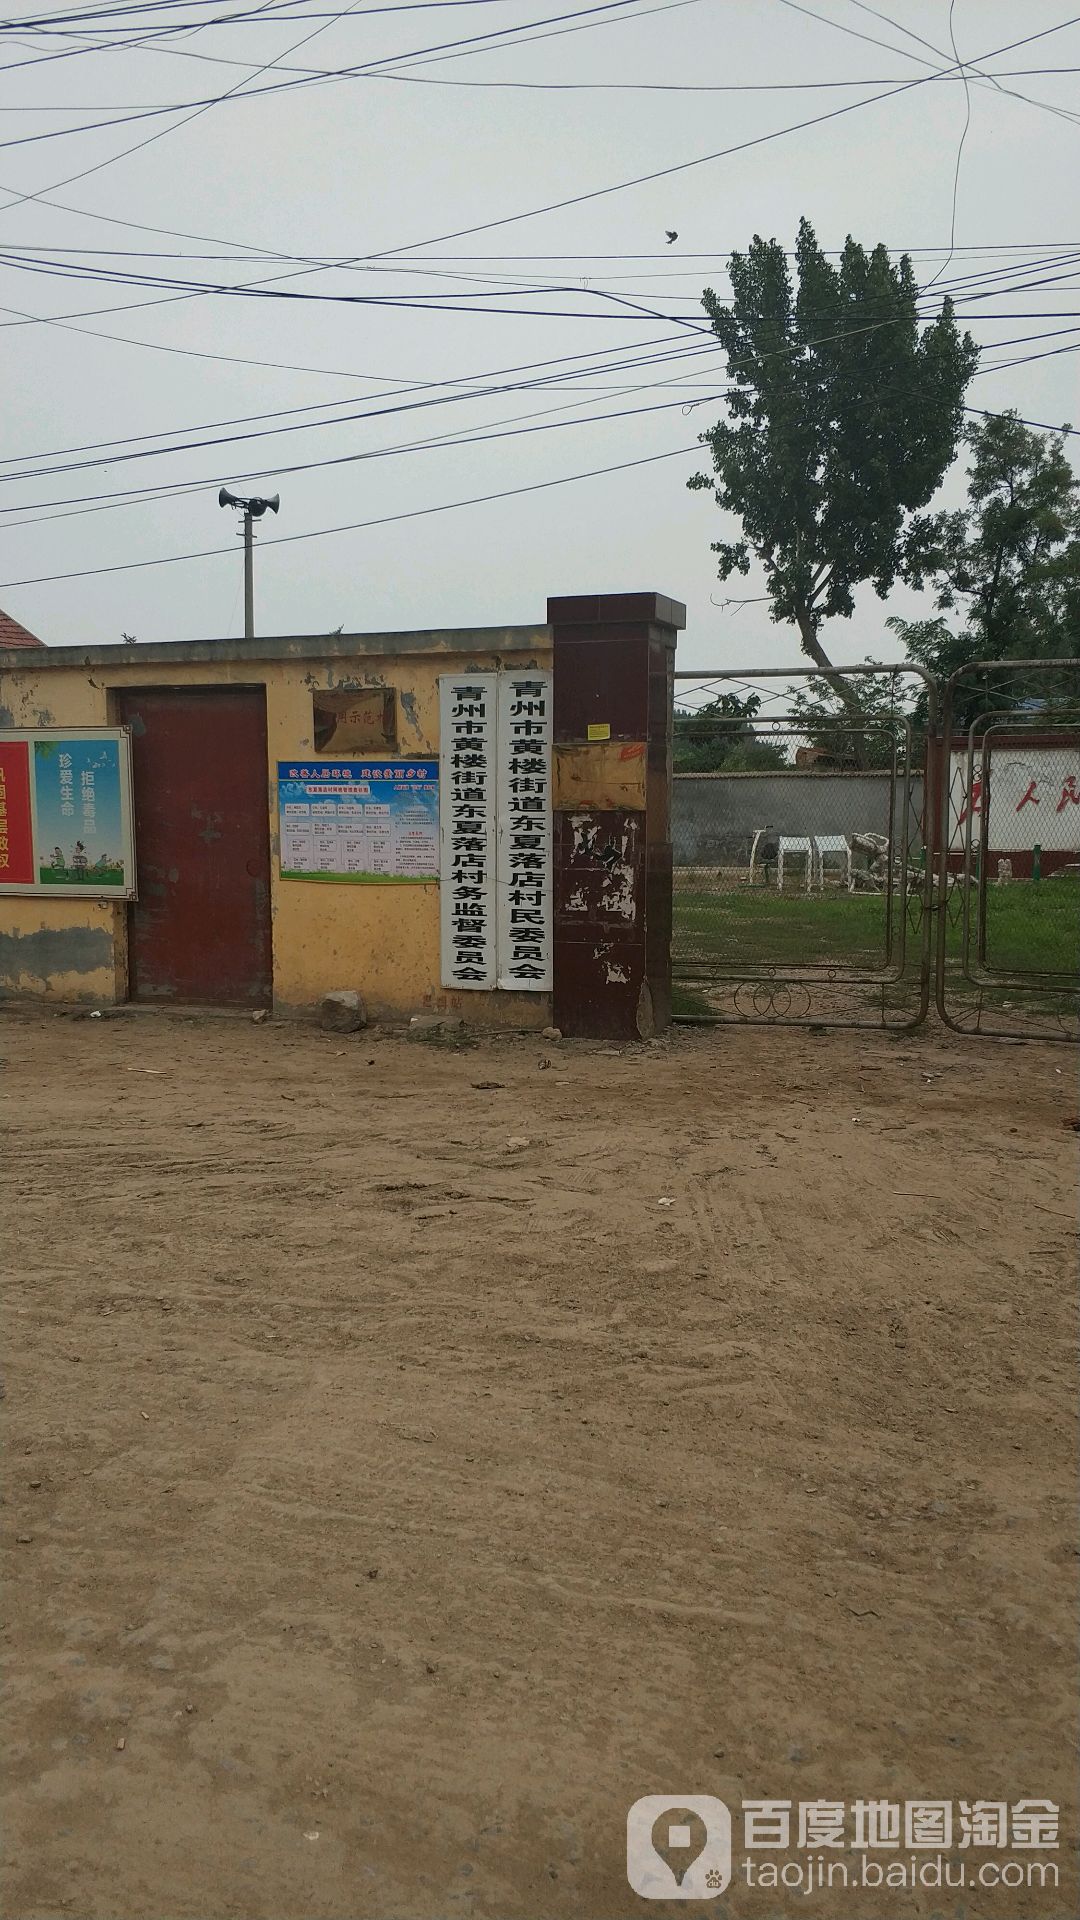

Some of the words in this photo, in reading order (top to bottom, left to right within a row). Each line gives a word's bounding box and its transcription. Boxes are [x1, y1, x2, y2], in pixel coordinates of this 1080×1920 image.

[59, 753, 74, 817] 珍爱生命
[81, 771, 97, 834] 拒绝毒品
[451, 686, 488, 981] 青州市黄楼街道东夏落店村务监督委员会
[508, 680, 548, 981] 青州市黄楼街道东夏落店村民委员会
